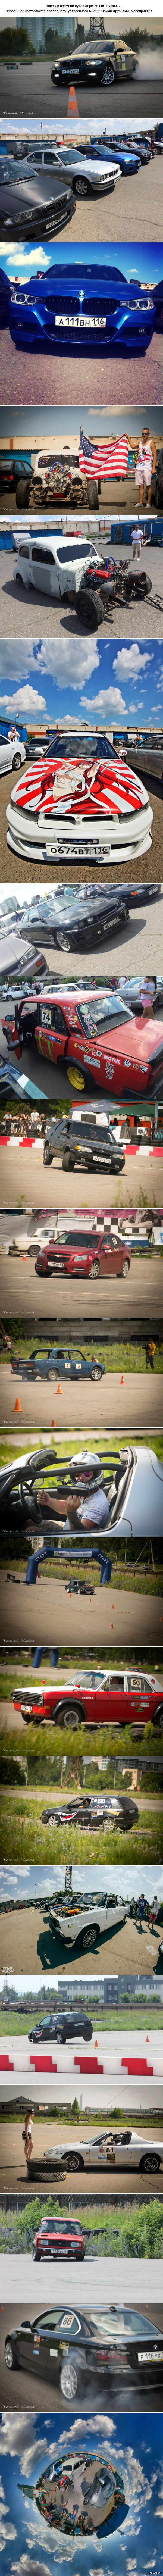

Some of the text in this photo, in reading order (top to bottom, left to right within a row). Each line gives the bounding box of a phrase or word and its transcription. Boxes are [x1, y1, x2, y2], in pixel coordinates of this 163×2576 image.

[43, 1012, 50, 1021] 74
[103, 1055, 120, 1064] MOTUL
[35, 1552, 47, 1561] СТАРТ
[98, 1553, 109, 1564] СТАРТ
